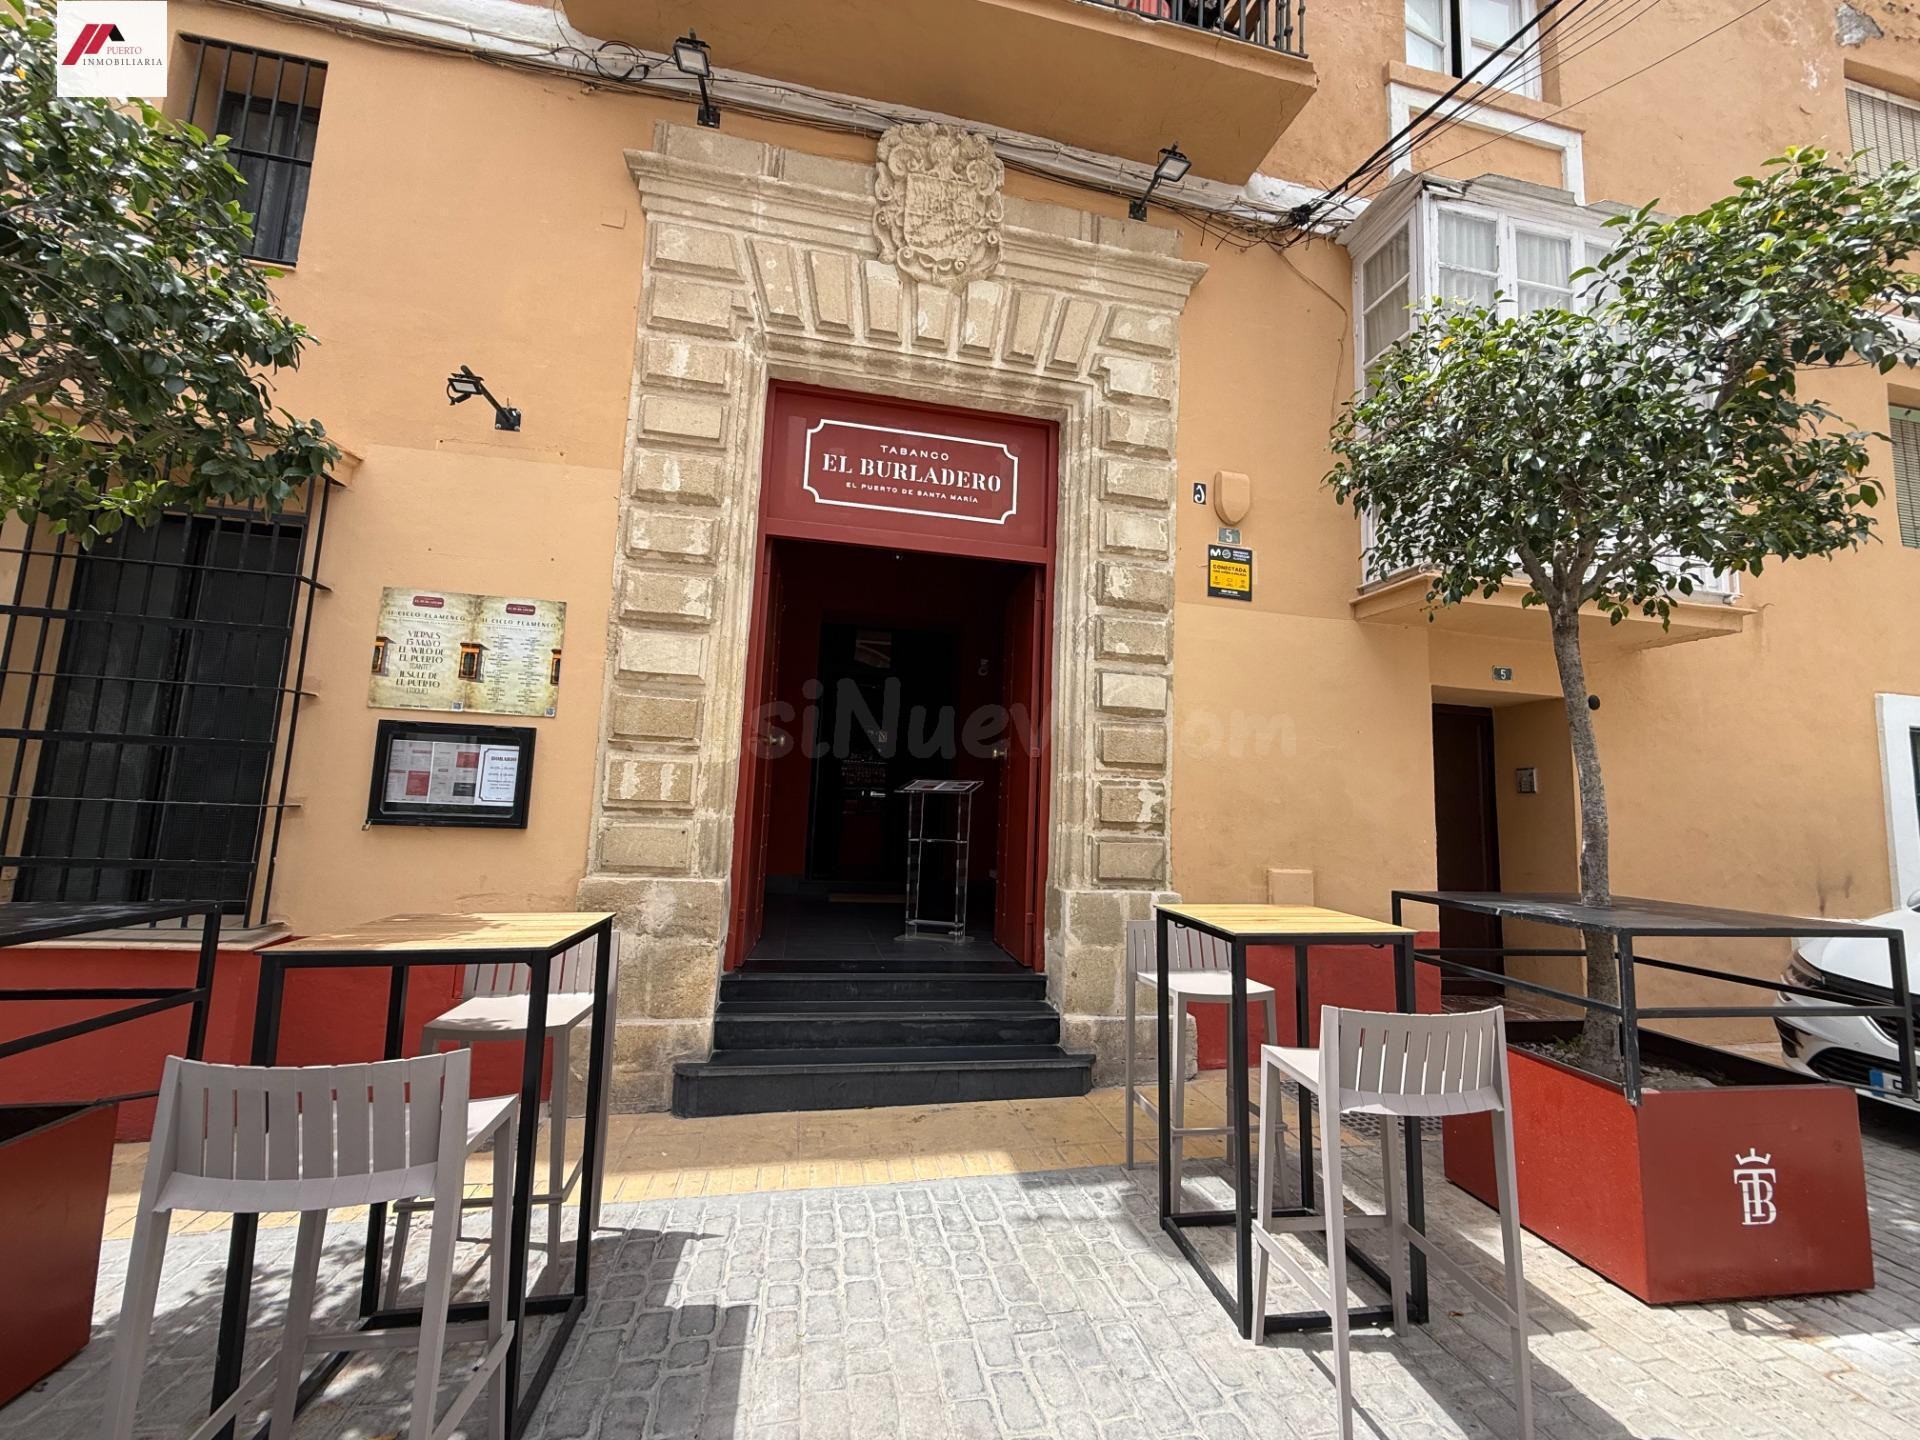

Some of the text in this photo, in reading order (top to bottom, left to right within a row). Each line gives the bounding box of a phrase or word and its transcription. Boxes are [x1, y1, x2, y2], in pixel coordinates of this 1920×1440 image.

[880, 444, 950, 461] TABANCO
[822, 453, 1001, 493] EL BURLADERO
[846, 481, 978, 504] EL PUERTO DE SANTA MARÍA
[1226, 529, 1233, 543] 5
[1213, 565, 1247, 573] CONECTADA
[397, 610, 421, 618] CICLO
[424, 612, 466, 622] FLAMENCO
[408, 630, 441, 640] VIERNES
[410, 655, 444, 664] PUERTO
[1500, 669, 1507, 680] 5
[407, 679, 441, 688] PUERTO
